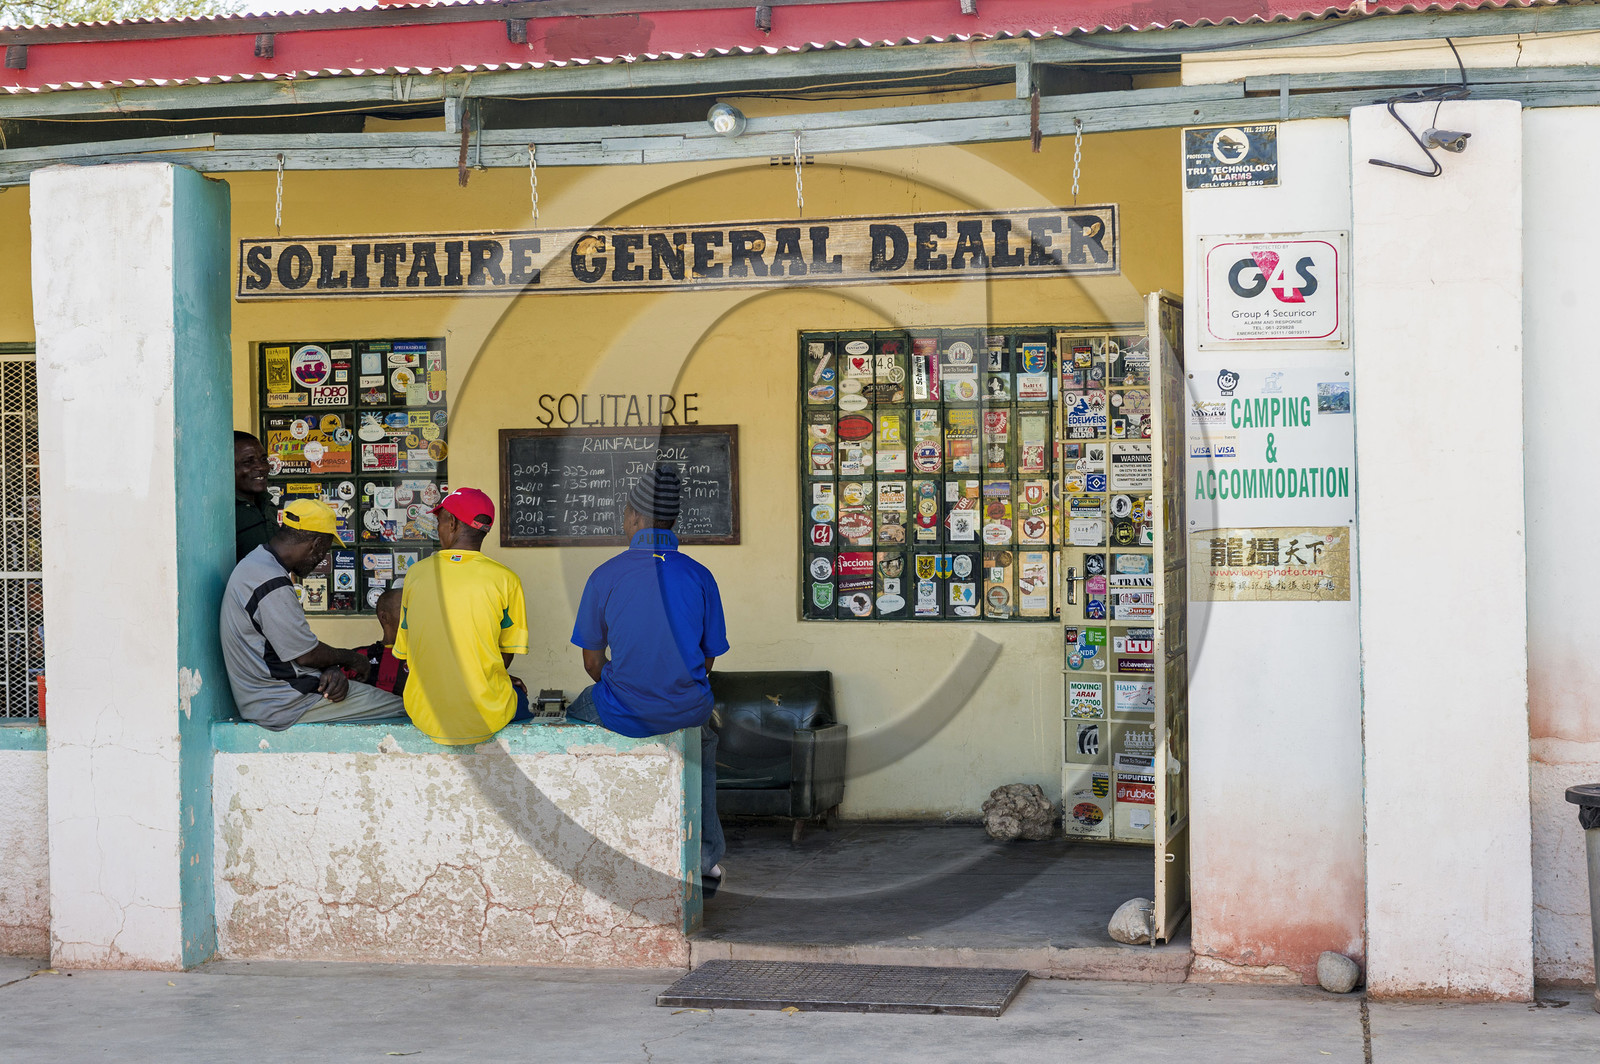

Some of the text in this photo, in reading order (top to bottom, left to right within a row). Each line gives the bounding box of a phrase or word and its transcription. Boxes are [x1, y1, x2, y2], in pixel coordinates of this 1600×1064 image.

[1209, 164, 1276, 174] TECHNOLOGY
[1212, 172, 1252, 182] ALARMS
[246, 215, 1109, 290] SOLITAIRE GENERAL DEALER
[1228, 251, 1318, 303] G4S
[1231, 309, 1262, 320] Group
[1273, 309, 1317, 317] Securicor
[314, 386, 348, 397] HOBO
[312, 396, 347, 405] reizen
[536, 393, 699, 427] SOLITAIRE
[1230, 396, 1311, 429] CAMPING
[1068, 415, 1107, 425] EDELWEISS
[582, 437, 655, 452] RAINFALL
[1265, 432, 1278, 464] &
[625, 461, 655, 475] JAN
[1195, 467, 1349, 500] ACCOMMODATION
[515, 494, 541, 506] 2011
[515, 510, 544, 524] 2012
[518, 525, 546, 535] 2013
[842, 558, 874, 567] acciona
[1127, 640, 1152, 652] LTU
